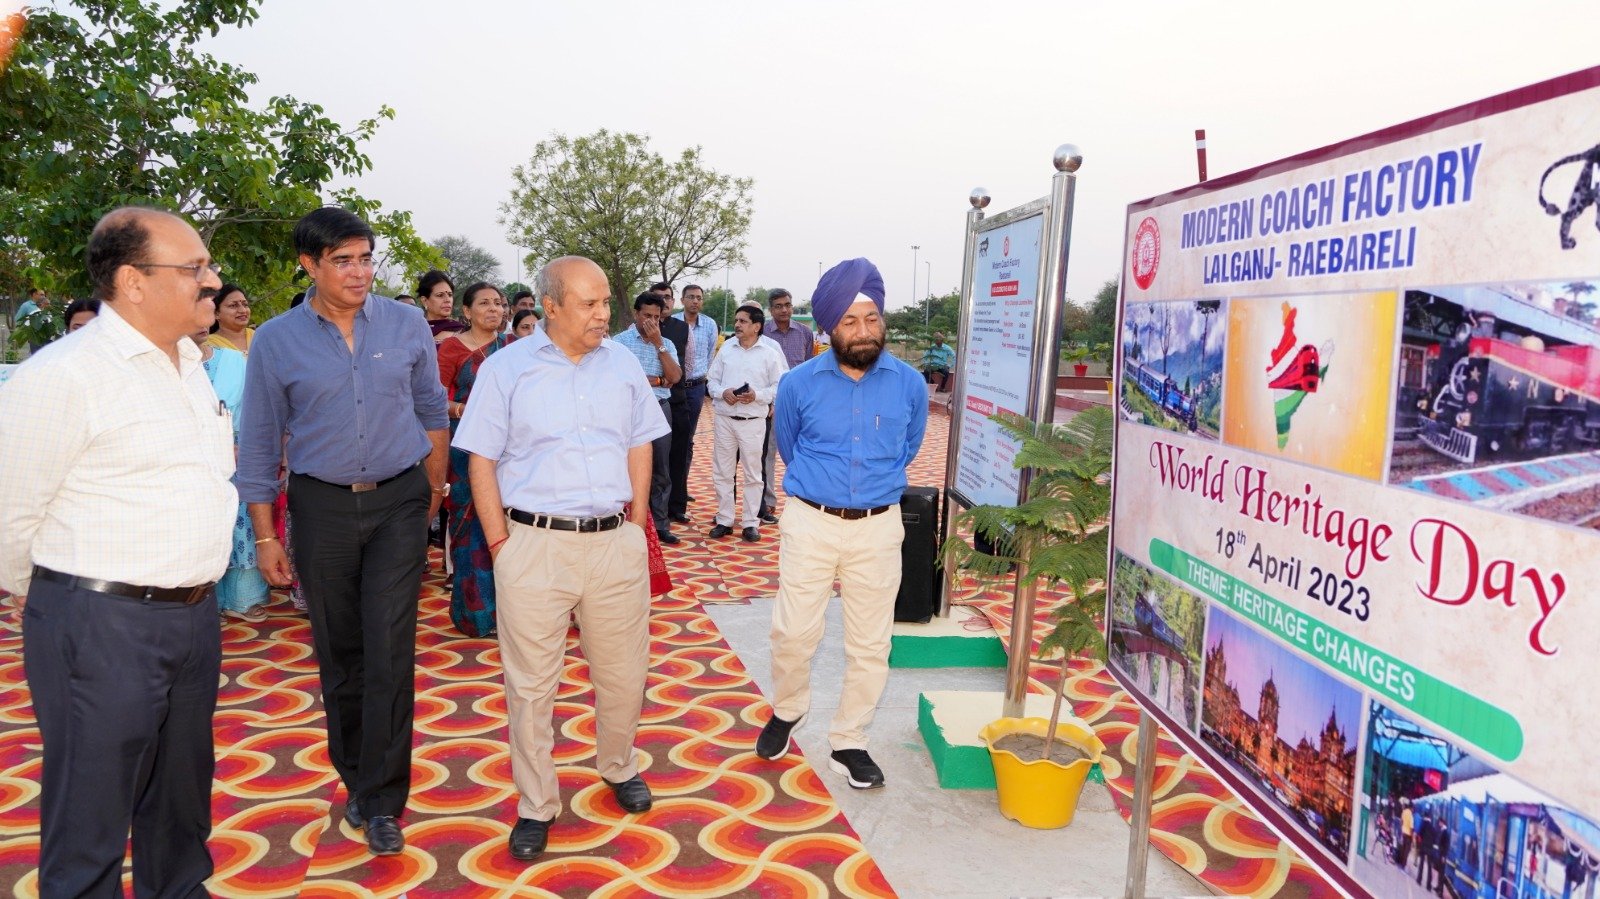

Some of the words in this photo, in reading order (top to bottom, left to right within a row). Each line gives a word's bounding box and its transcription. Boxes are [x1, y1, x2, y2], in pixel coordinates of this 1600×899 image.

[1181, 199, 1254, 249] MODERN
[1259, 183, 1333, 237] COACH
[1341, 143, 1483, 222] FACTORY
[1203, 244, 1282, 285] LALGANJ-
[1287, 227, 1417, 277] RAEBARELI
[1150, 441, 1228, 504] World
[1234, 464, 1393, 580] Heritage
[1410, 518, 1567, 656] Day
[1215, 526, 1247, 559] 18th
[1248, 541, 1302, 591] April
[1307, 566, 1371, 622] 2023
[1187, 558, 1231, 602] THEME:
[1233, 584, 1308, 645] HERITAGE
[1313, 626, 1416, 701] CHANGES
